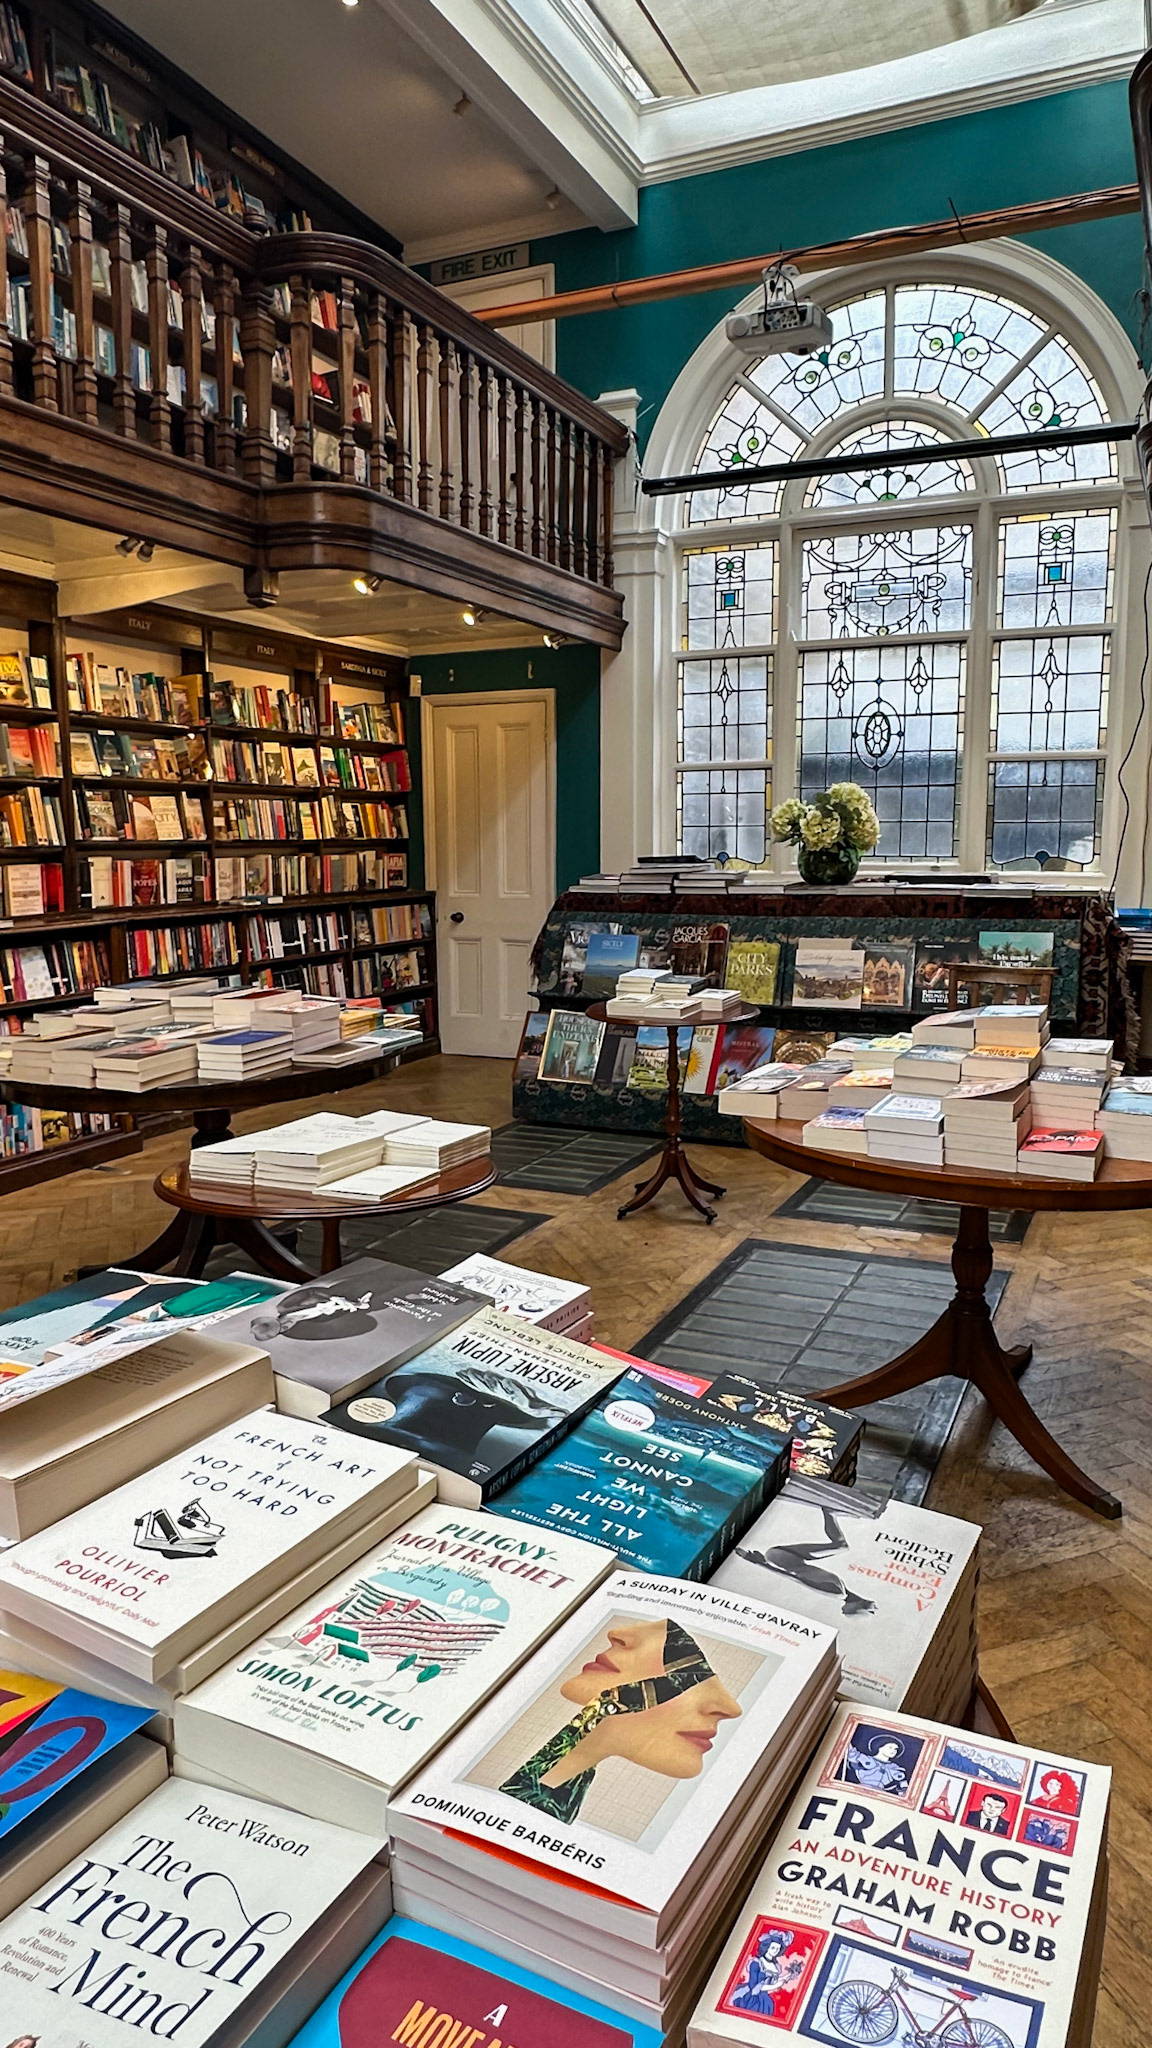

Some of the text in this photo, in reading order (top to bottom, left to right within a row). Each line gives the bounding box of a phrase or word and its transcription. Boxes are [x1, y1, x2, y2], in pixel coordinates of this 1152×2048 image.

[442, 249, 517, 280] FIRE EXIT
[128, 618, 151, 631] ITALY
[257, 644, 275, 656] ITALY
[672, 934, 703, 944] GARCIA
[673, 925, 708, 936] JACQUES
[730, 964, 774, 976] PARKS
[737, 952, 768, 964] CITY
[993, 952, 1041, 962] This must be
[695, 1027, 715, 1036] RITZ
[731, 1040, 760, 1048] MISTRAL
[467, 1329, 592, 1379] GENTLEMAN-THIEF
[484, 1319, 605, 1370] MAURICE LEBLANC
[510, 1354, 583, 1393] ARSÈNE
[654, 1391, 693, 1412] DOERR
[610, 1410, 645, 1428] NETFLIX
[695, 1406, 748, 1431] ANTHONY
[234, 1431, 377, 1479] FRENCH ART
[642, 1442, 684, 1463] SEE
[192, 1454, 336, 1506] NOT TRYING
[599, 1451, 694, 1488] CANNOT
[180, 1470, 299, 1517] TOO HARD
[610, 1477, 647, 1497] WE
[575, 1490, 649, 1520] LIGHT
[510, 1508, 652, 1564] THE MULTI-MILLION COPY BESTSELLER
[545, 1502, 644, 1541] ALL THE
[435, 1523, 559, 1562] PULIGNY-
[874, 1531, 954, 1565] Bedford
[82, 1546, 170, 1586] OLLIVIER
[377, 1549, 428, 1566] Journal
[427, 1560, 446, 1573] of
[456, 1563, 493, 1588] Village
[392, 1532, 575, 1590] MONTRACHET
[884, 1547, 950, 1577] Sybille
[884, 1559, 943, 1588] Error
[54, 1559, 147, 1602] POURRIOL
[392, 1565, 449, 1592] Burgundy
[848, 1562, 938, 1601] Compass
[70, 1587, 160, 1628] and Daily Mail
[617, 1579, 823, 1640] A SUNDAY IN VILLE-d'AVRAY
[917, 1598, 934, 1613] A
[644, 1595, 661, 1605] and
[660, 1598, 705, 1616] immensely
[750, 1625, 772, 1637] Irish
[773, 1632, 801, 1648] Times
[236, 1658, 323, 1693] SIMON
[260, 1695, 272, 1703] one
[271, 1697, 281, 1705] of
[279, 1699, 289, 1708] the
[288, 1703, 303, 1713] best
[302, 1708, 320, 1720] books
[278, 1692, 290, 1700] one
[299, 1698, 308, 1706] the
[307, 1702, 321, 1711] best
[320, 1706, 341, 1719] books
[318, 1683, 426, 1733] LOFTUS
[410, 1793, 511, 1832] DOMINIQUE
[185, 1803, 310, 1858] Peter Watson
[118, 1834, 192, 1883] The
[511, 1824, 607, 1870] BARBÉRIS
[797, 1795, 1071, 1906] FRANCE
[787, 1837, 1064, 1930] AN ADVENTURE HISTORY
[771, 1903, 823, 1920] Alan Johnson
[774, 1897, 794, 1905] write
[776, 1859, 1058, 1963] GRAHAM ROBB
[784, 1891, 803, 1900] fresh
[806, 1897, 821, 1906] way
[822, 1900, 832, 1908] to
[30, 1859, 293, 1988] French
[38, 1926, 78, 1948] 400 Years
[0, 1943, 67, 1977] Revolution and
[18, 1936, 68, 1963] of Romance,
[0, 1961, 40, 1983] Renewal
[977, 1959, 1010, 1975] homage
[1012, 1970, 1021, 1978] to
[992, 1972, 1036, 1990] The Times
[1007, 1962, 1039, 1976] erudite
[46, 1947, 215, 2041] Mind
[483, 2003, 509, 2028] A
